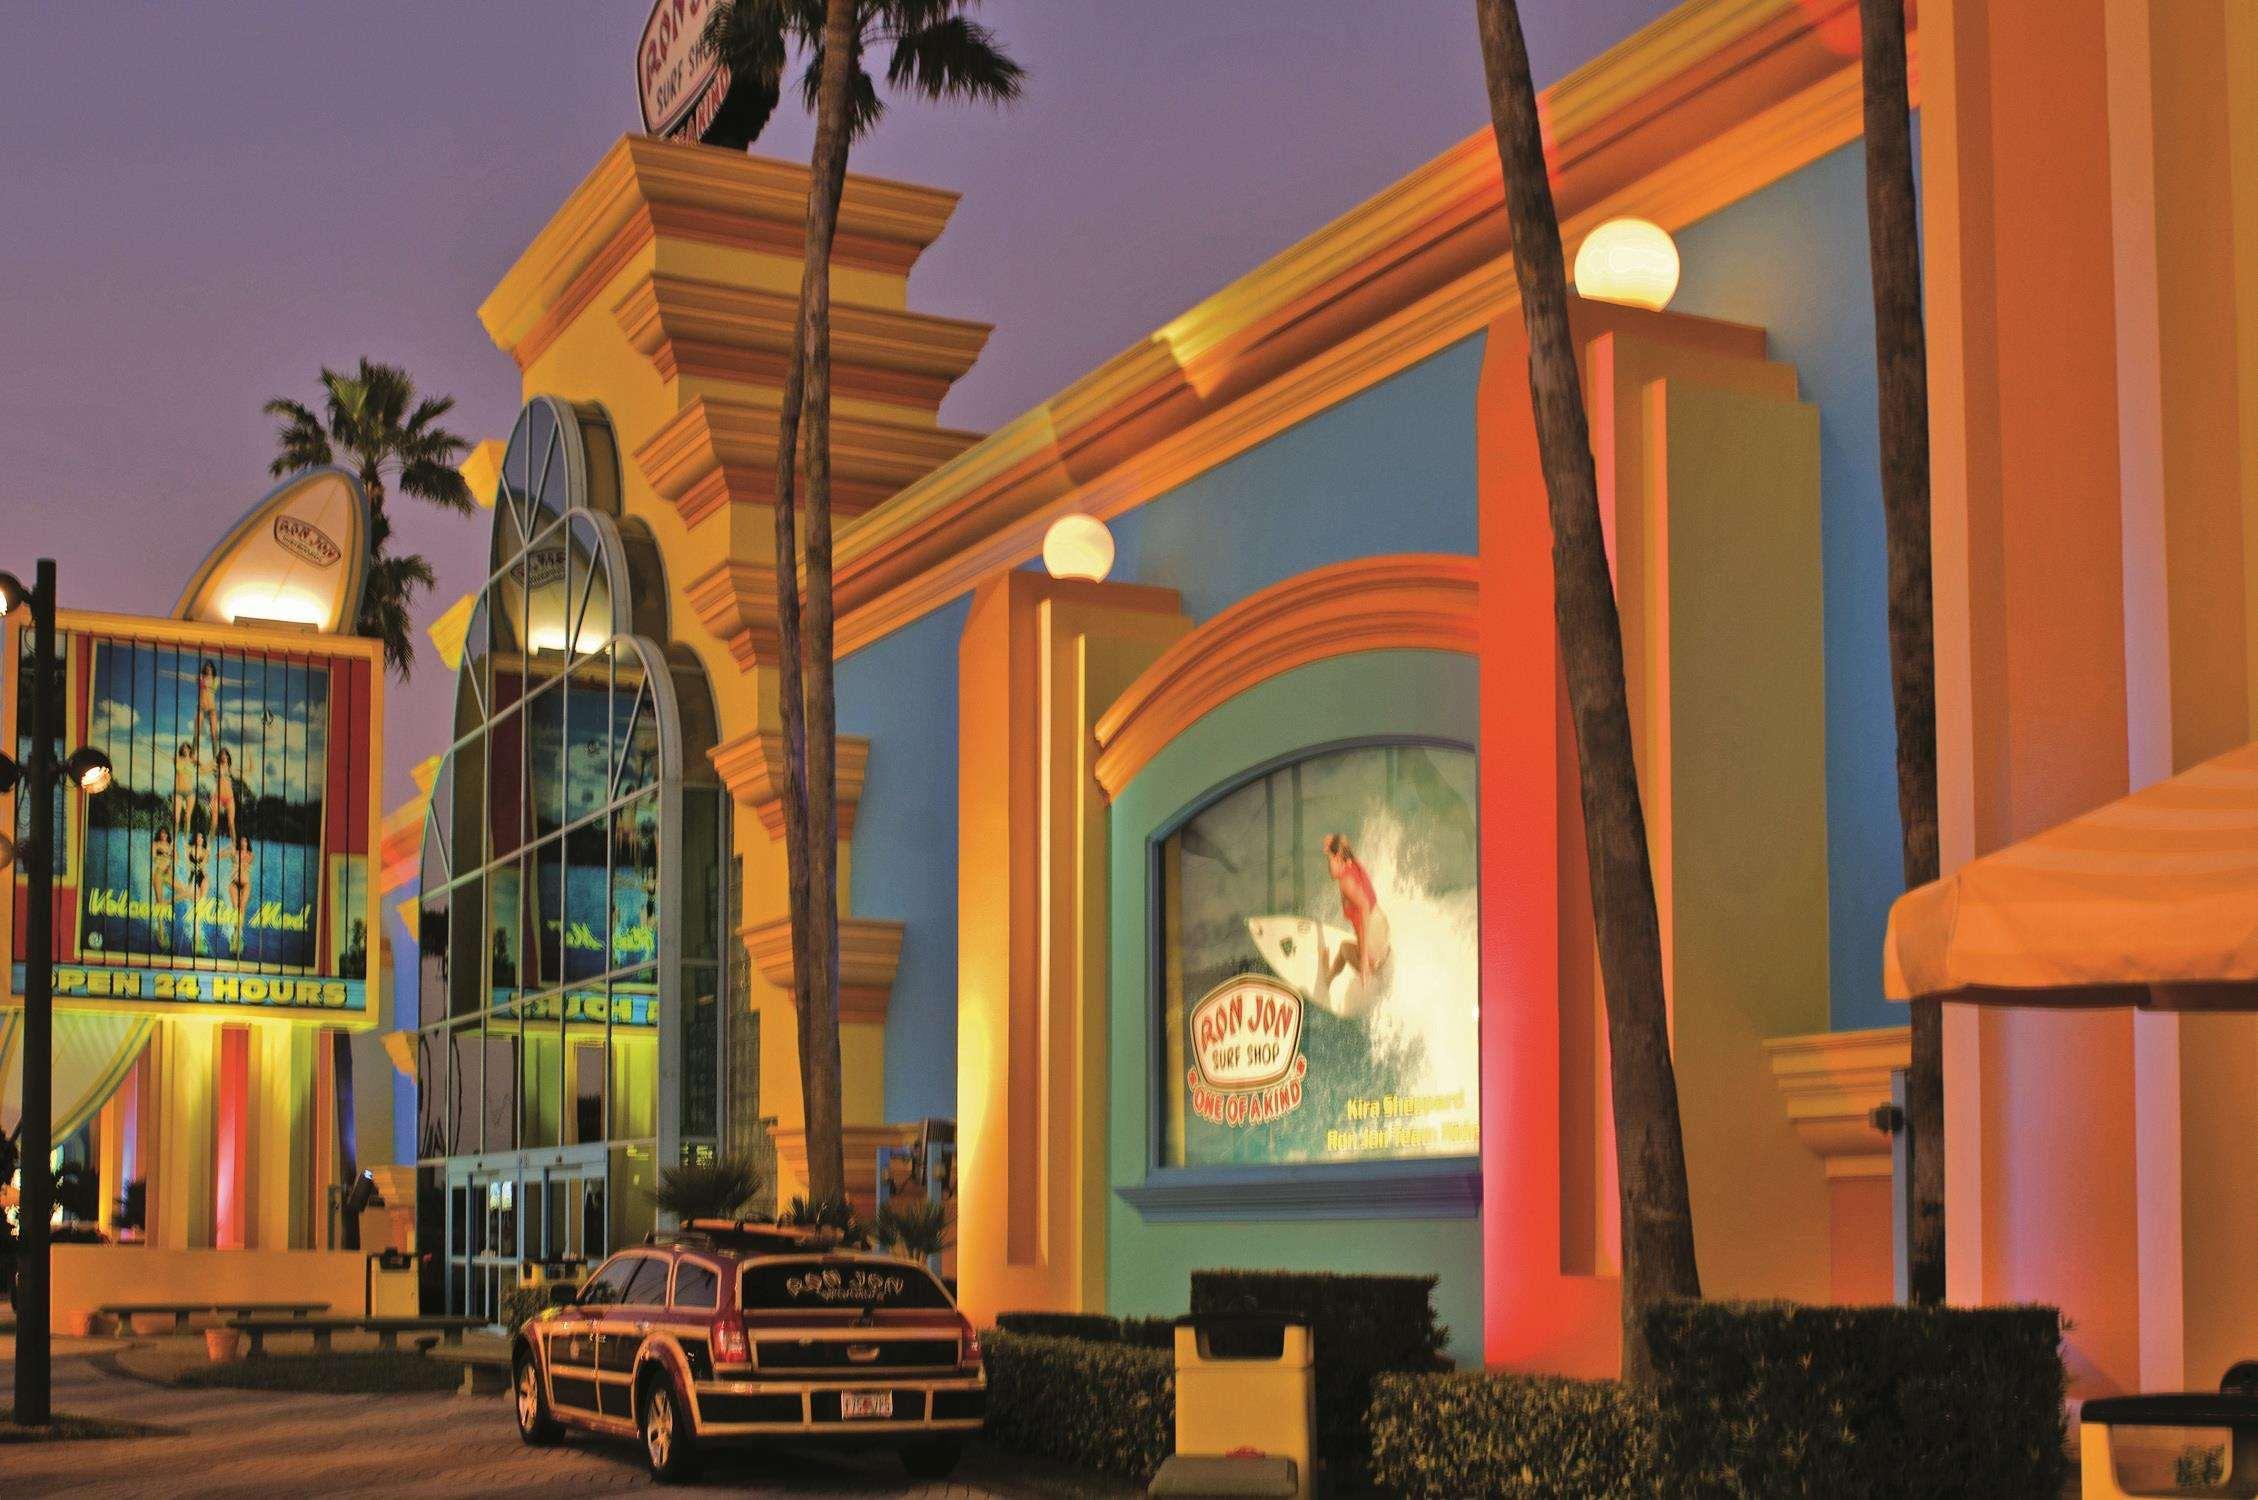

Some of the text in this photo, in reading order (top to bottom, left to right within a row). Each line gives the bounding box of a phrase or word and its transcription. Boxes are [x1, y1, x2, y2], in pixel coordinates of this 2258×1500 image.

[51, 968, 347, 1008] PEN 24 HOURS
[1201, 994, 1294, 1054] RON JON
[1212, 1042, 1280, 1072] SURF SHOP
[1193, 1078, 1302, 1126] ONE OF A KIND
[1347, 1097, 1380, 1121] Kira
